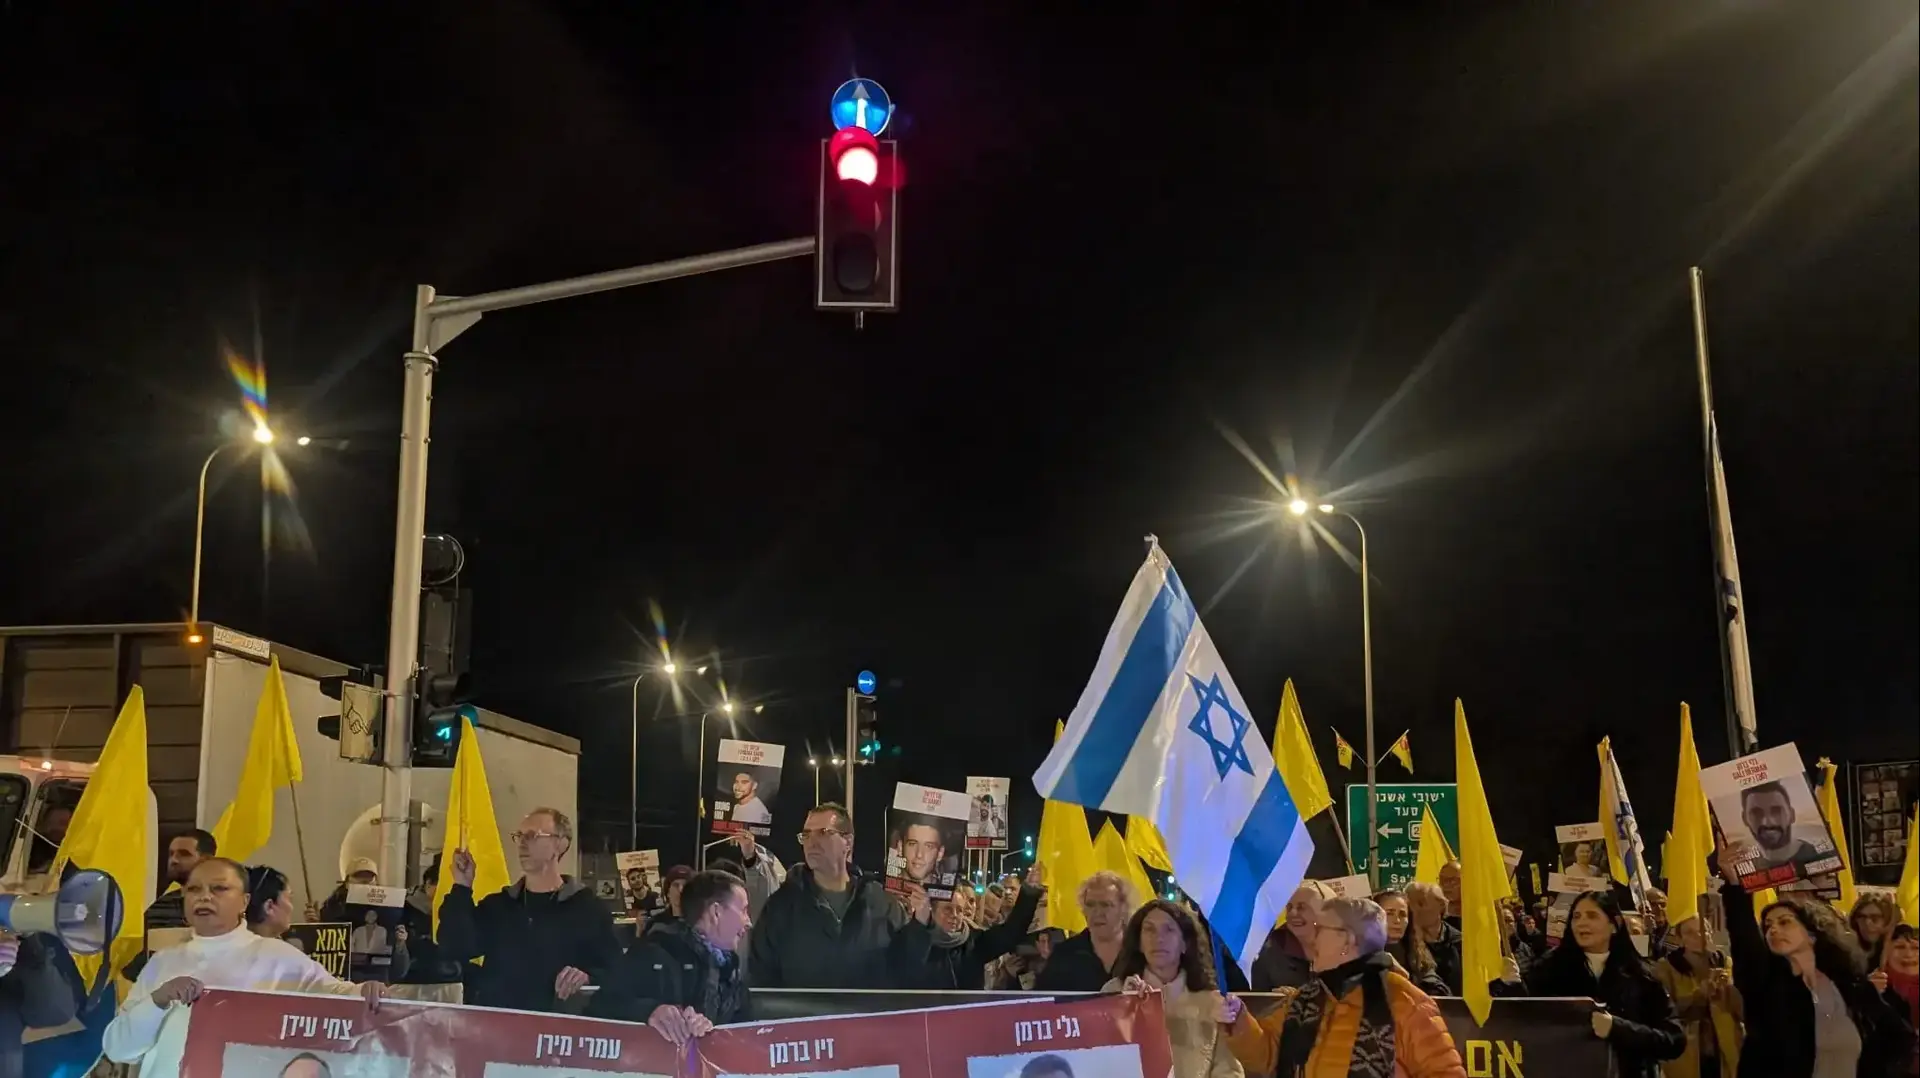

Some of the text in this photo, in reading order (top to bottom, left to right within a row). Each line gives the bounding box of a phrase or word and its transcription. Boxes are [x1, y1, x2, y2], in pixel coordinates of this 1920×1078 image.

[1375, 792, 1445, 803] ישובי אשכו
[1735, 860, 1757, 877] HIM
[316, 928, 347, 951] אמא
[280, 1014, 353, 1040] צחי עידן
[1015, 1015, 1081, 1047] גלי ברמן
[536, 1033, 621, 1060] עמרי מירן
[769, 1038, 834, 1068] זיו ברמן
[1466, 1040, 1524, 1078] אם
